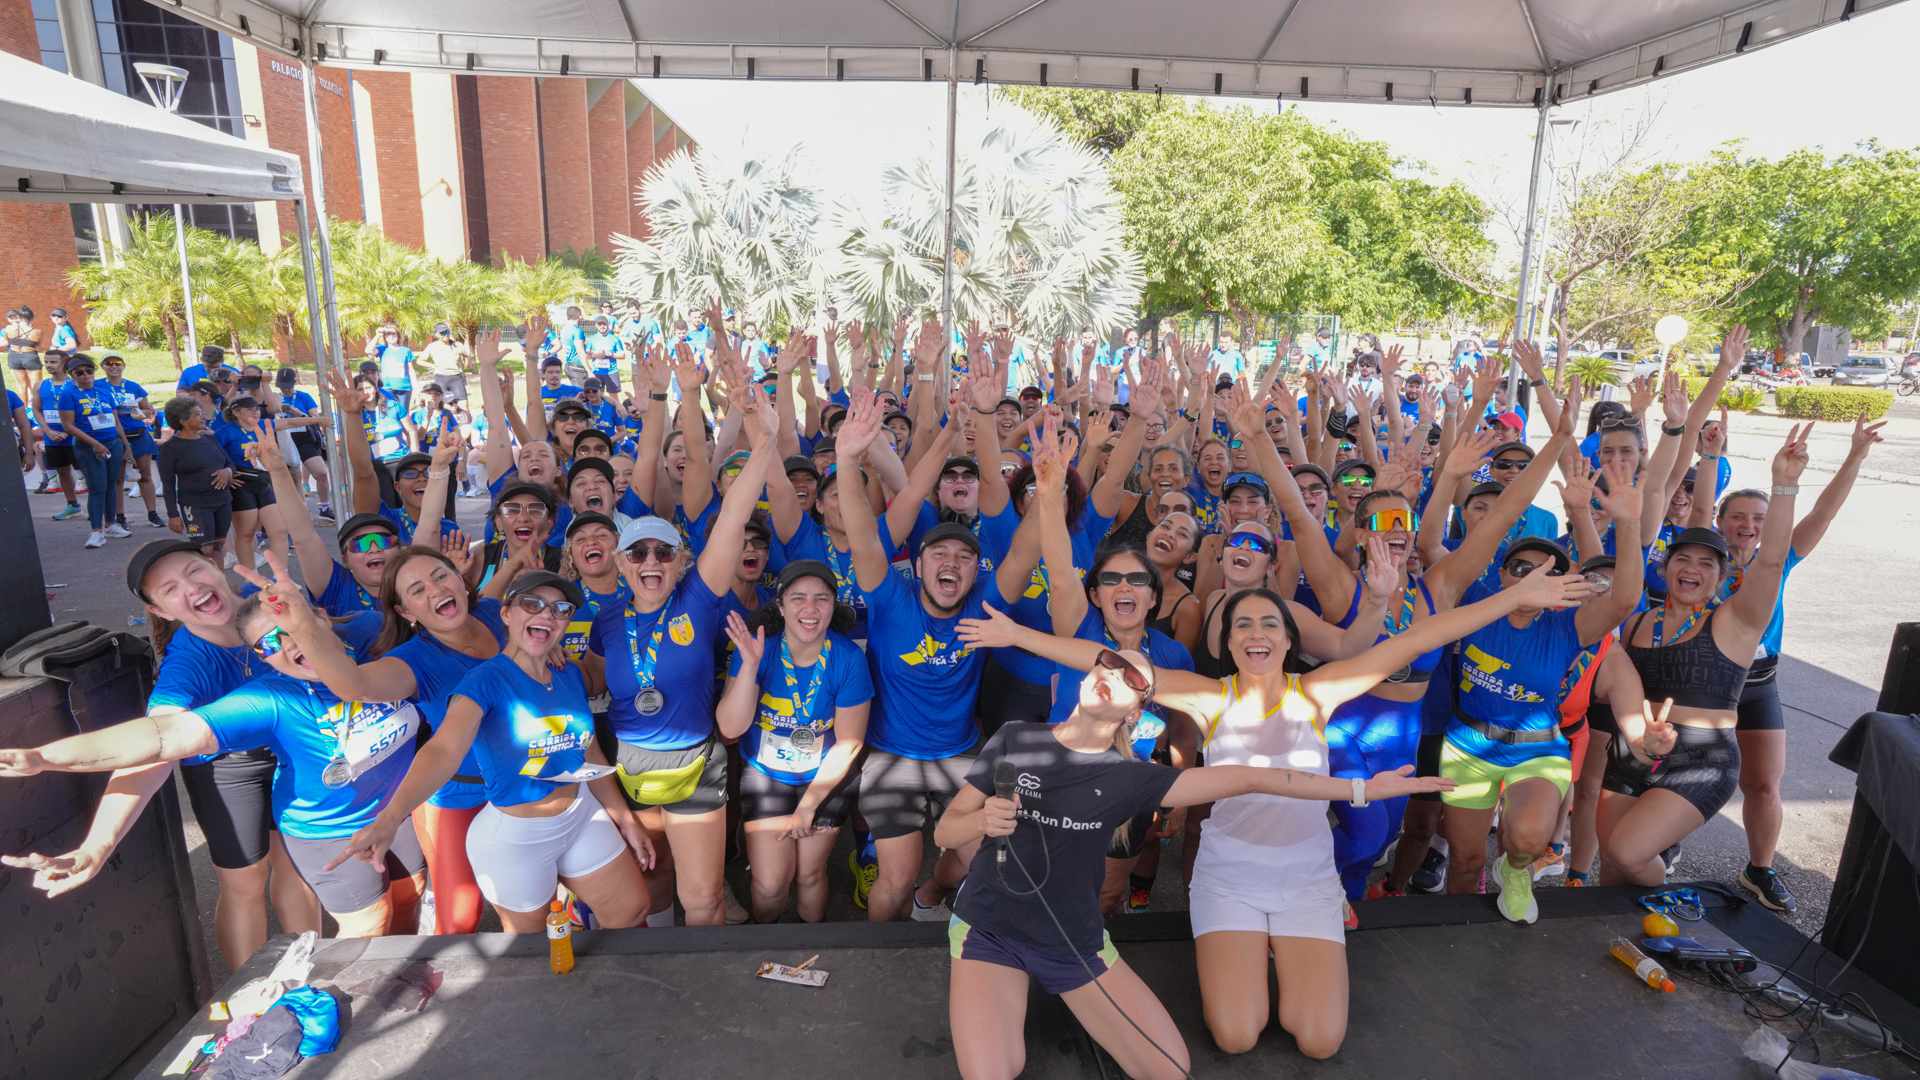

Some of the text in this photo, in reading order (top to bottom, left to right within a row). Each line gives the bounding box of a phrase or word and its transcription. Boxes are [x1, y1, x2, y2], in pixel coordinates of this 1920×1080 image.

[271, 60, 303, 80] PALÁCIO
[1468, 673, 1502, 694] JUSTIÇA
[1661, 666, 1708, 685] LIVE!
[370, 722, 408, 758] 5577
[542, 741, 574, 757] JUSTIÇA
[776, 748, 811, 762] 5214
[1025, 789, 1042, 799] GAMA
[1031, 810, 1058, 827] Run
[1062, 816, 1102, 830] Dance
